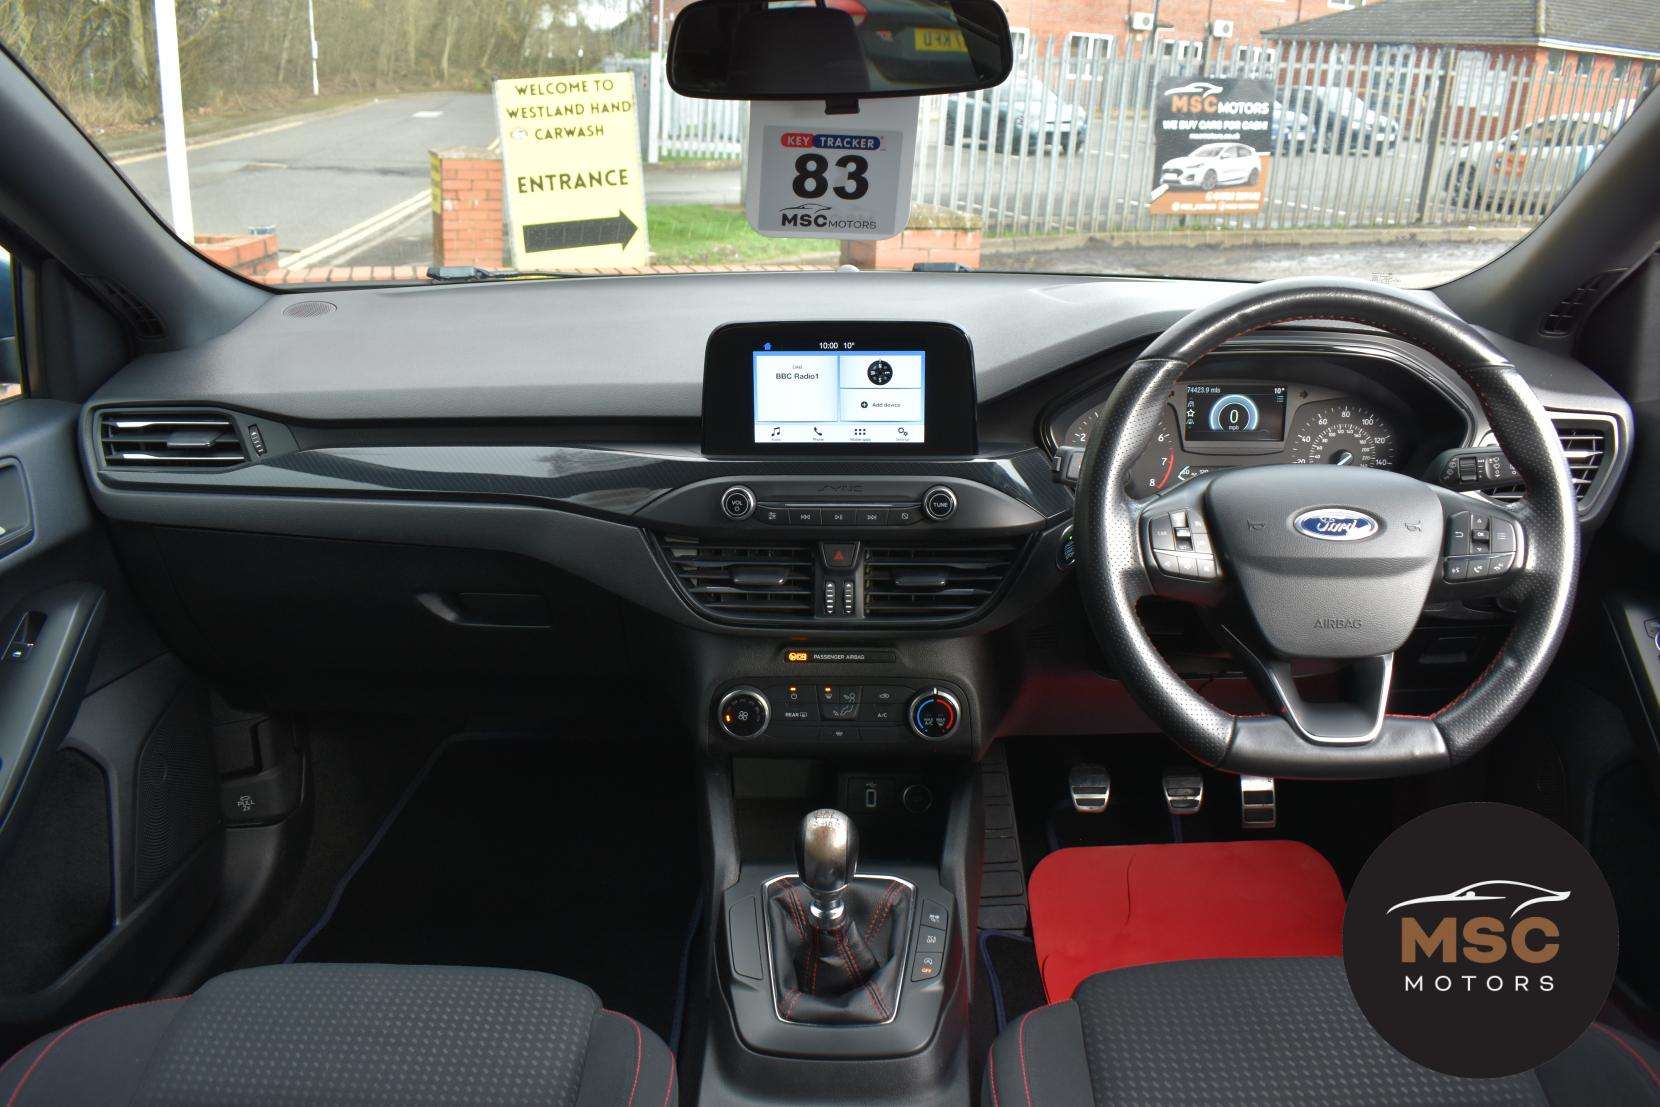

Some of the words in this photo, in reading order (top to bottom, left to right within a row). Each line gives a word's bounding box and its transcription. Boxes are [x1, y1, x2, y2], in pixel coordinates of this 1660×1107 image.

[515, 81, 588, 95] WELCOME
[594, 80, 613, 92] TO
[507, 104, 584, 119] WESTLAND
[591, 101, 631, 114] HAND
[1171, 95, 1218, 113] MSC
[1218, 101, 1269, 115] MOTORS
[535, 125, 604, 140] CARWASH
[1163, 120, 1178, 130] WE
[1179, 120, 1198, 130] BUY
[1198, 120, 1222, 130] CARS
[1223, 120, 1241, 130] FOR
[787, 136, 810, 145] KEY
[820, 137, 874, 148] TRACKER
[518, 169, 628, 193] ENTRANCE
[793, 153, 868, 200] 83
[781, 214, 827, 227] MSC
[828, 220, 876, 230] MOTORS
[1230, 409, 1239, 424] 0
[1158, 434, 1164, 442] 6
[1161, 457, 1167, 465] 7
[1149, 478, 1155, 487] 8
[1316, 516, 1357, 532] Ford
[1313, 619, 1361, 630] AIRBAG
